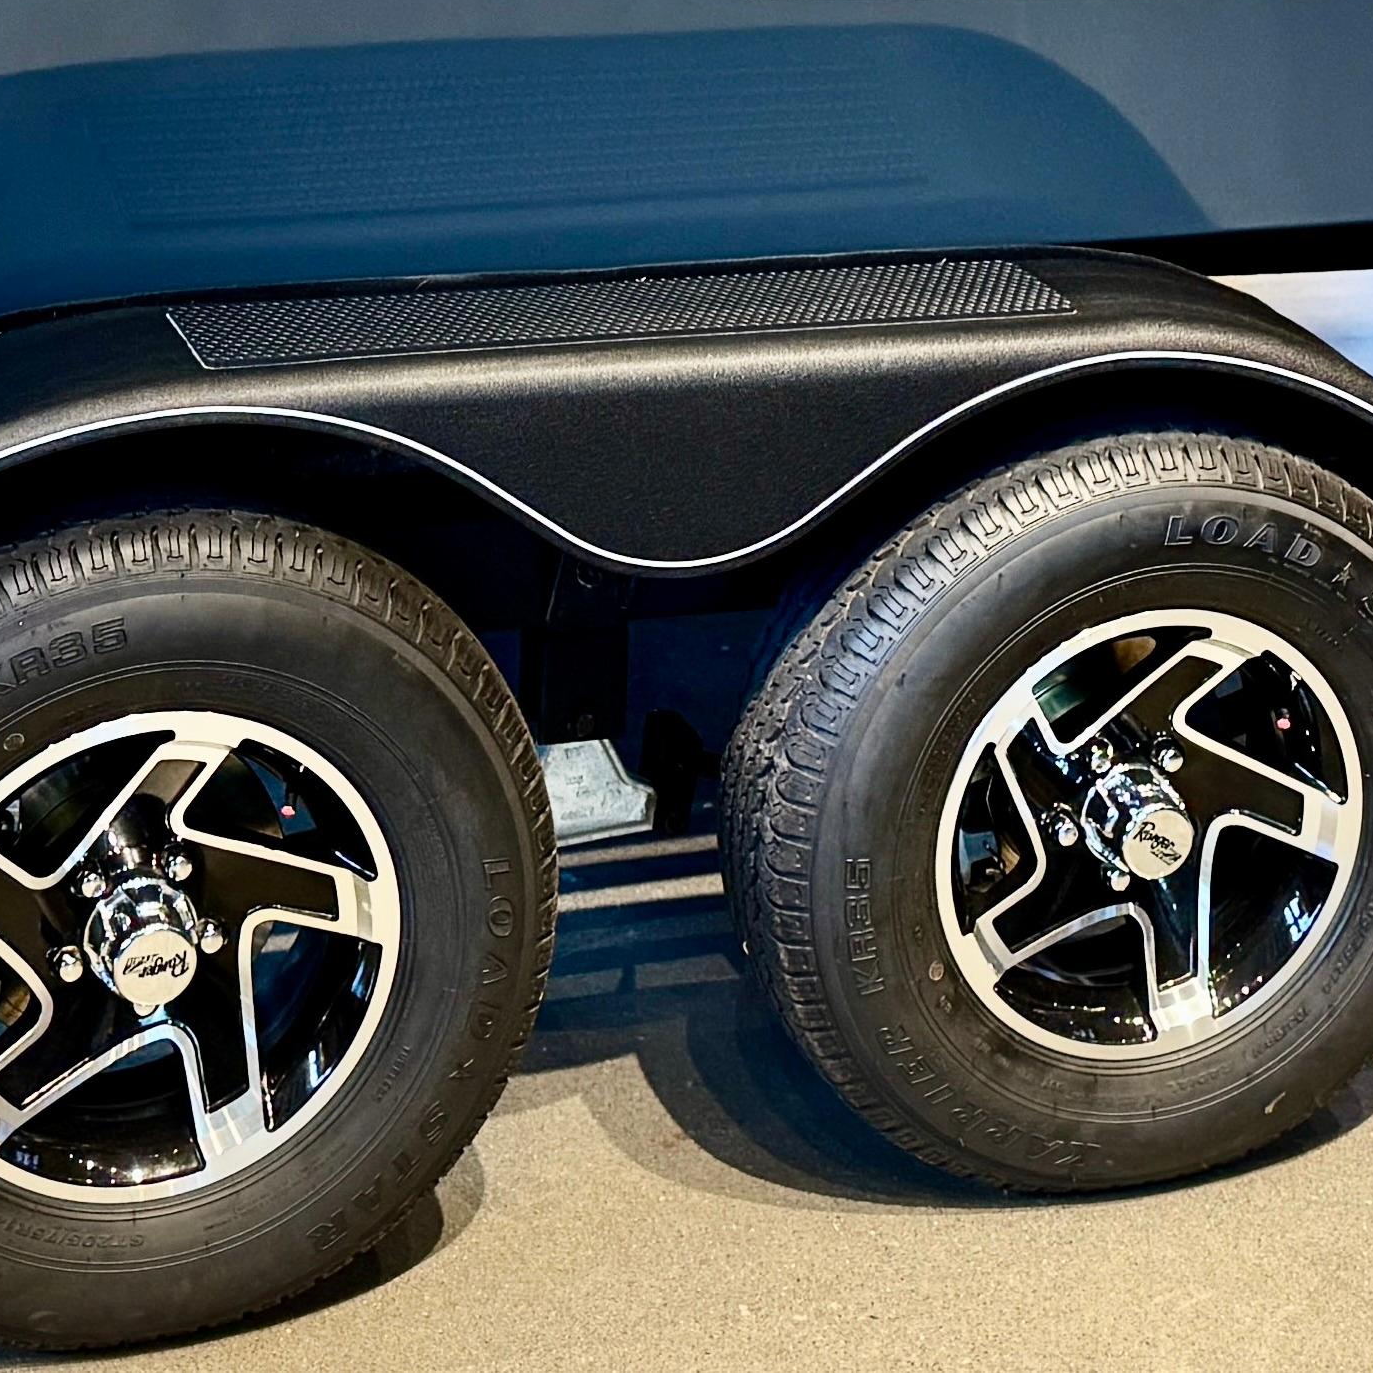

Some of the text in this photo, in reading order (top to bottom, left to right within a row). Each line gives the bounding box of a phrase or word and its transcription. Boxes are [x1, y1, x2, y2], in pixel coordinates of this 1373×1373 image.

[1164, 513, 1324, 568] LOAD
[1132, 821, 1176, 850] Ranger
[305, 857, 517, 1251] LOAD STAR
